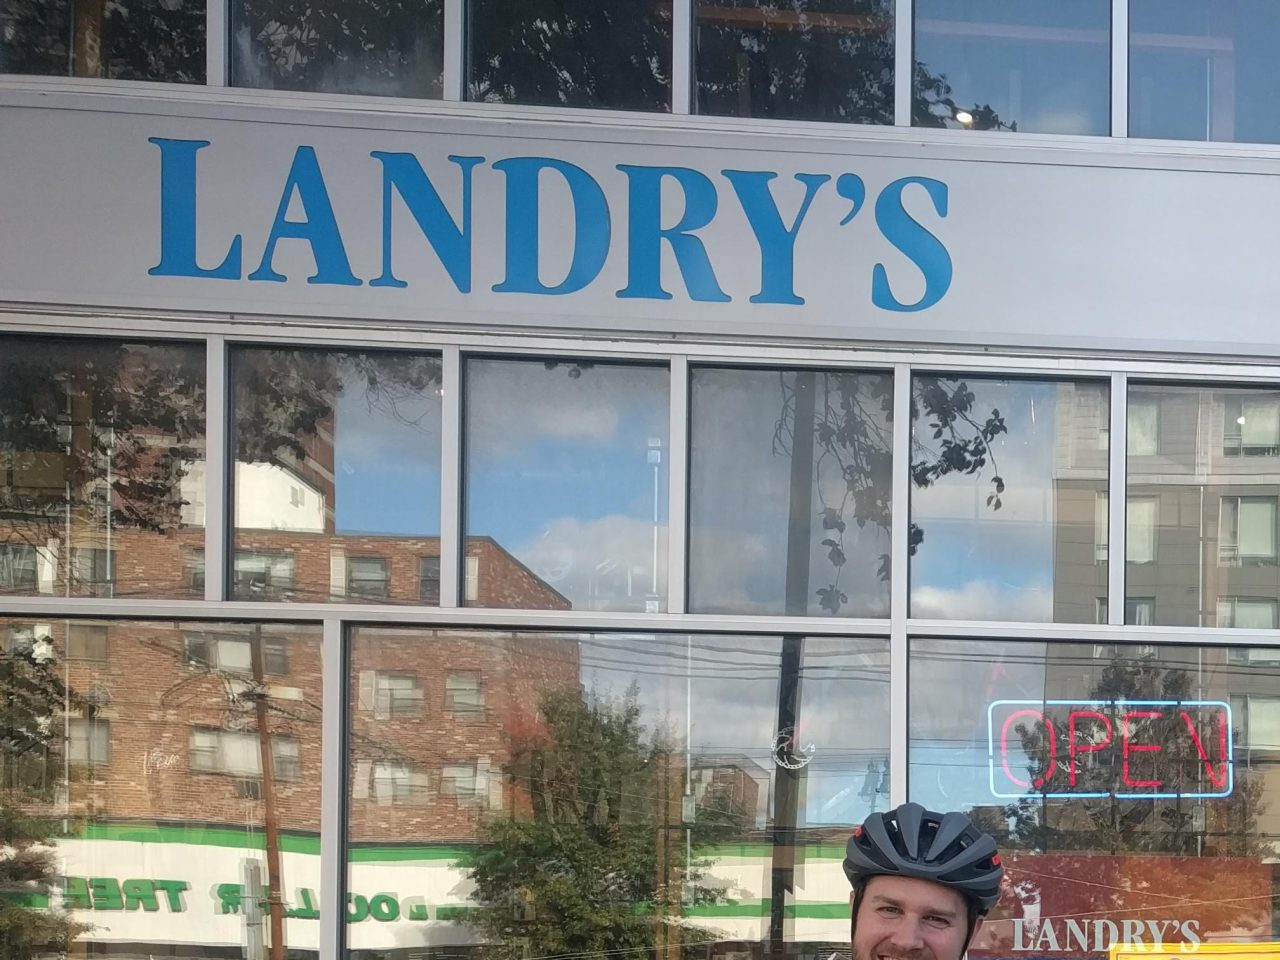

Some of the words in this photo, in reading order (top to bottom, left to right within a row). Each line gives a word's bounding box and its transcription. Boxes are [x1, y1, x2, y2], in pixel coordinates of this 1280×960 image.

[147, 136, 954, 313] LANDRY'S
[1001, 709, 1226, 788] OPEN
[1011, 918, 1201, 952] LANDRY'S
